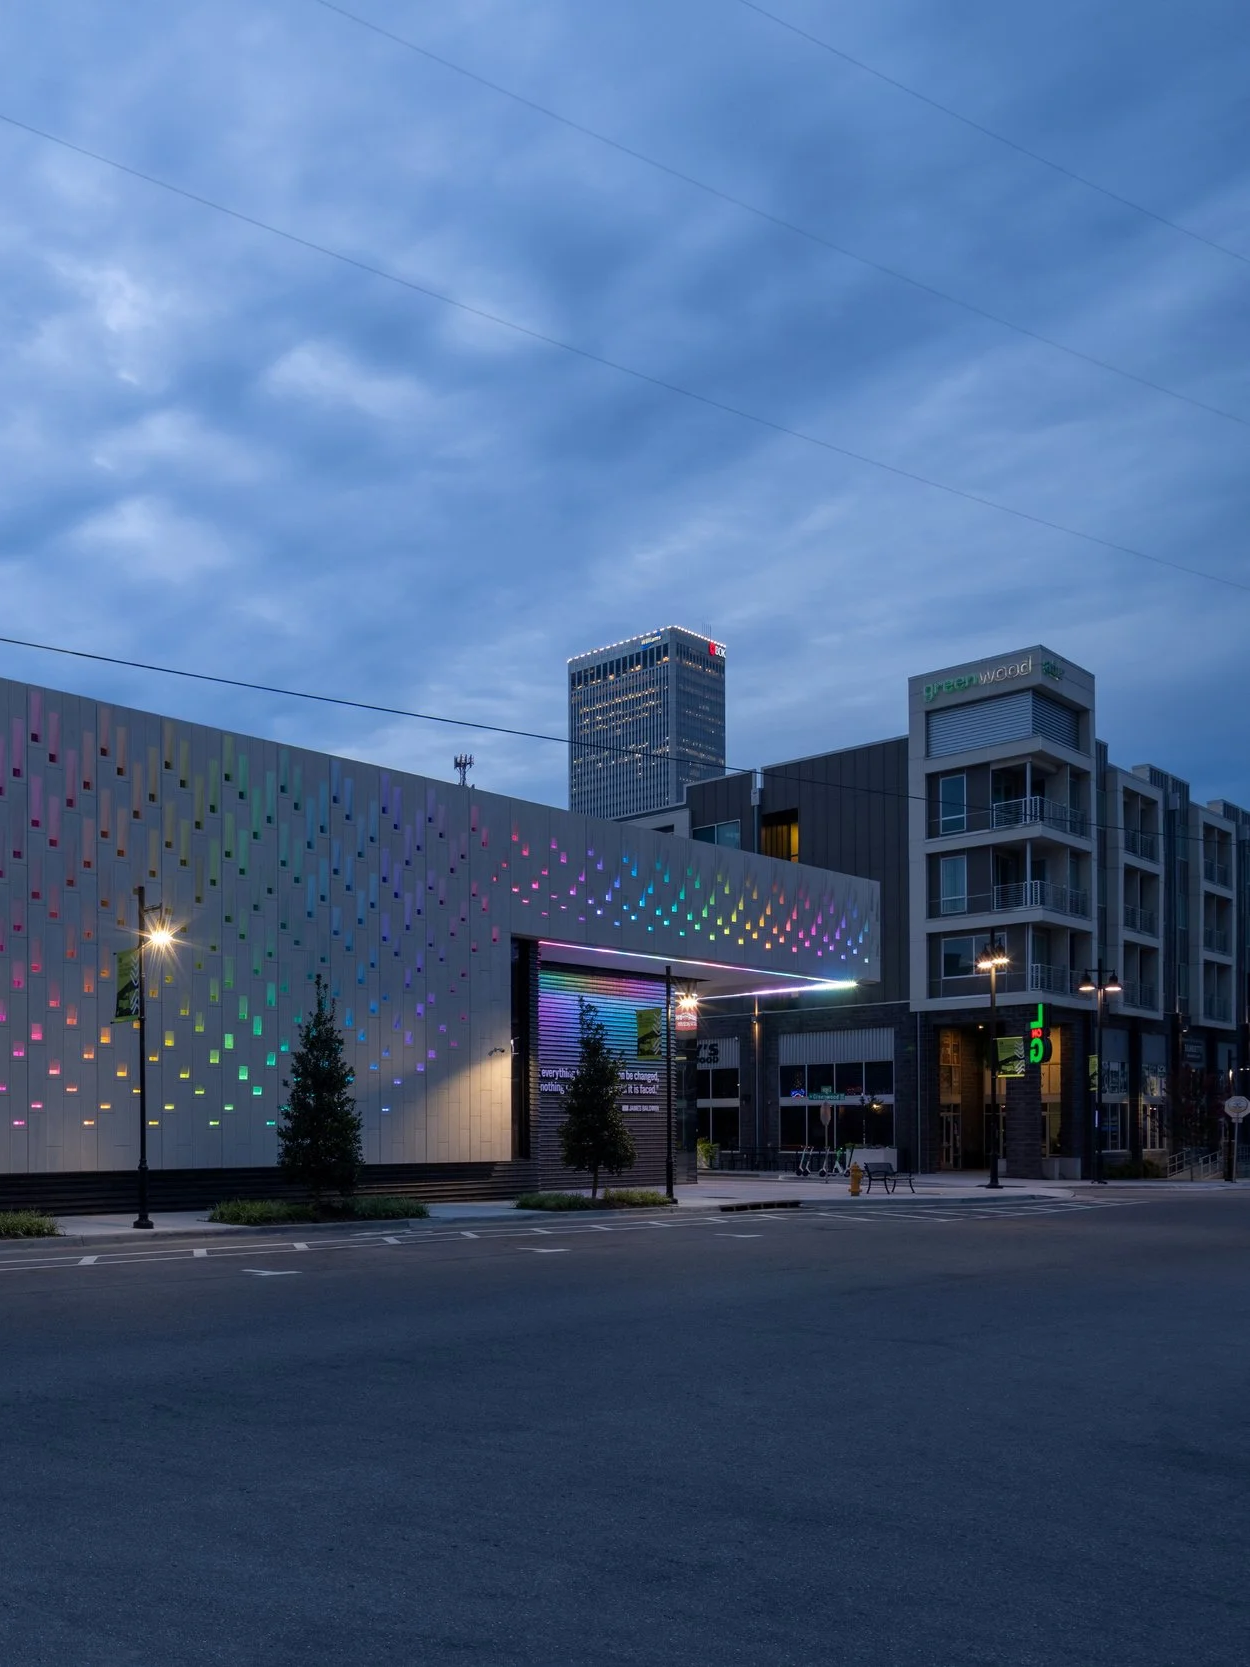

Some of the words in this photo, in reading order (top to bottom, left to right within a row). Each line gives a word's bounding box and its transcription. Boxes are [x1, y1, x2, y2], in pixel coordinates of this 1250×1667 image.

[923, 655, 1032, 703] greenwood
[697, 1056, 719, 1064] OOD
[541, 1068, 576, 1081] everything
[625, 1070, 633, 1080] be
[634, 1071, 660, 1083] changed,
[540, 1081, 565, 1095] nothing
